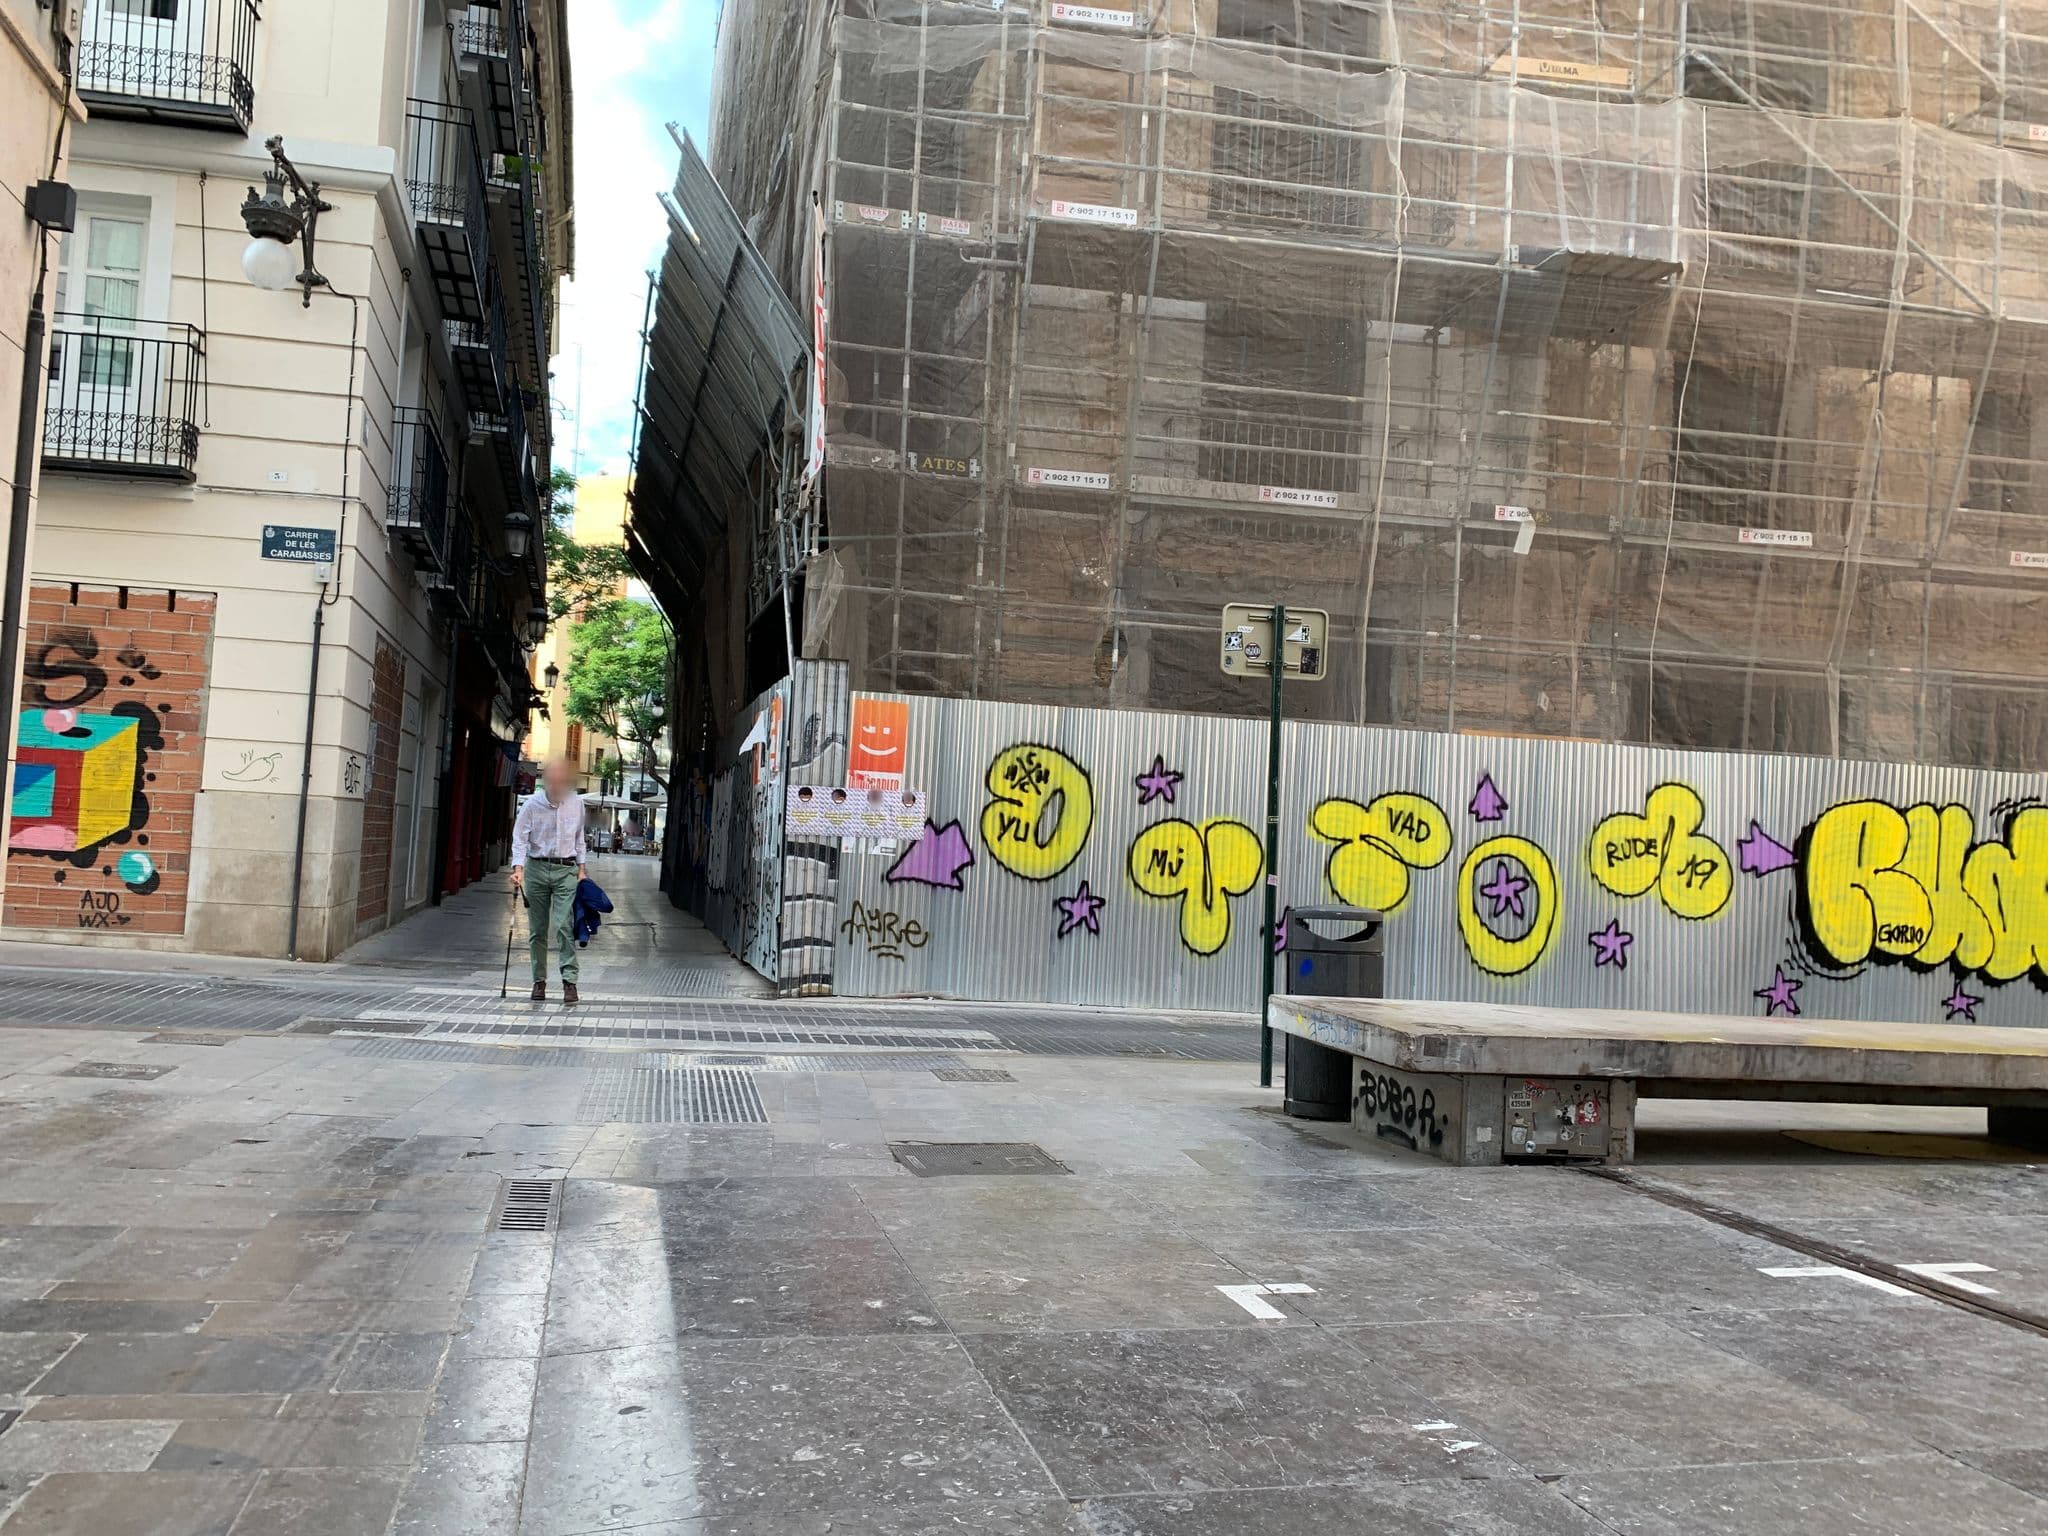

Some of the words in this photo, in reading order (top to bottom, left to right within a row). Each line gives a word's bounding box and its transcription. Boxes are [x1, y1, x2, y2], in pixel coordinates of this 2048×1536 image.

[1077, 10, 1092, 18] 902
[1077, 207, 1094, 216] 902
[1098, 209, 1107, 218] 17
[1125, 213, 1135, 221] 17
[922, 456, 967, 473] ATES
[1051, 473, 1068, 482] 902
[1071, 475, 1081, 483] 17
[1084, 476, 1094, 484] 15
[1282, 492, 1298, 500] 902
[1314, 495, 1324, 503] 15
[1326, 496, 1336, 504] 17
[284, 530, 319, 540] CARRER
[285, 540, 297, 548] DE
[299, 541, 316, 549] LES
[270, 549, 332, 561] CARABASSES
[1386, 806, 1432, 843] VAD
[1605, 836, 1659, 869] RUDE
[80, 889, 120, 913] AJO
